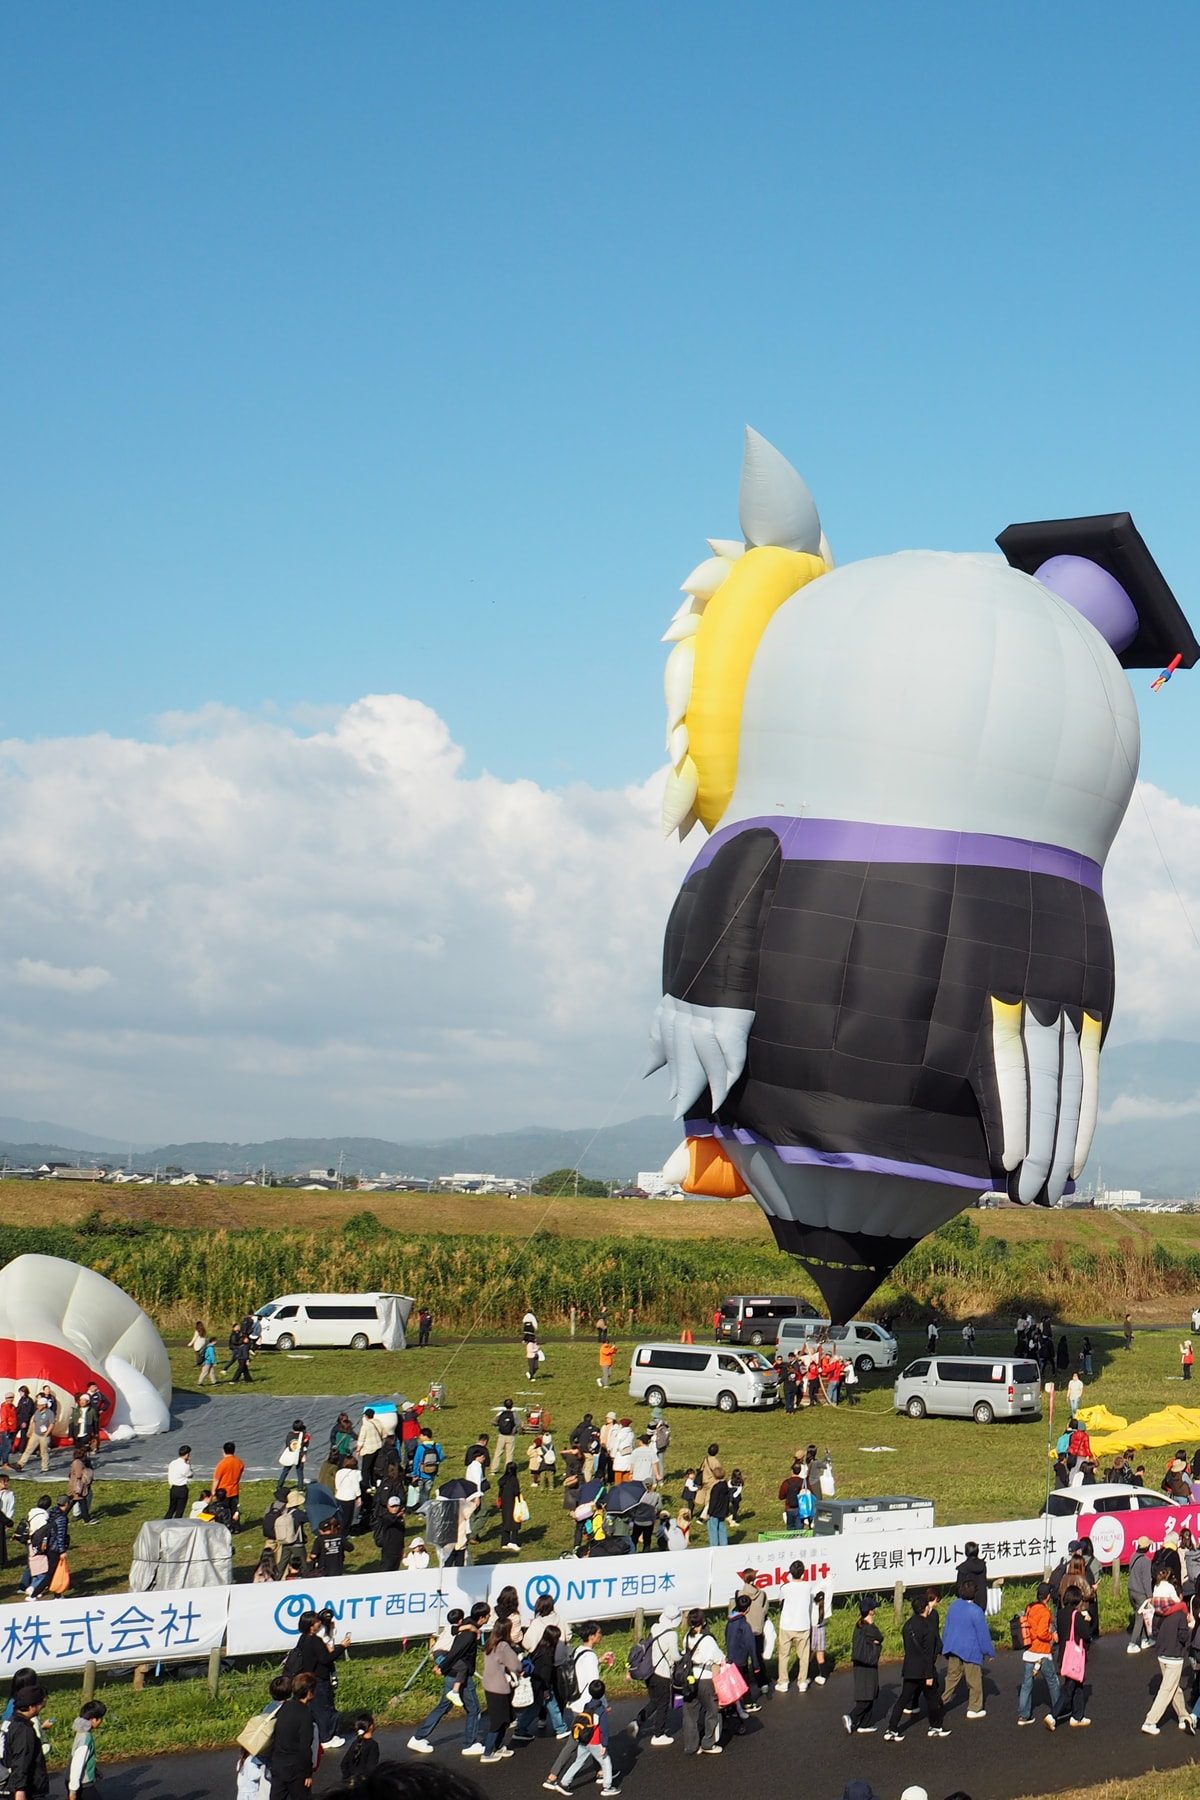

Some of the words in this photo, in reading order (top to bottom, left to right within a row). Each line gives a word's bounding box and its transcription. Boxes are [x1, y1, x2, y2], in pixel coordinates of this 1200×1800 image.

[855, 1536, 1057, 1572] 佐賀県ヤクルト売株式会社
[2, 1601, 201, 1663] 株式会社
